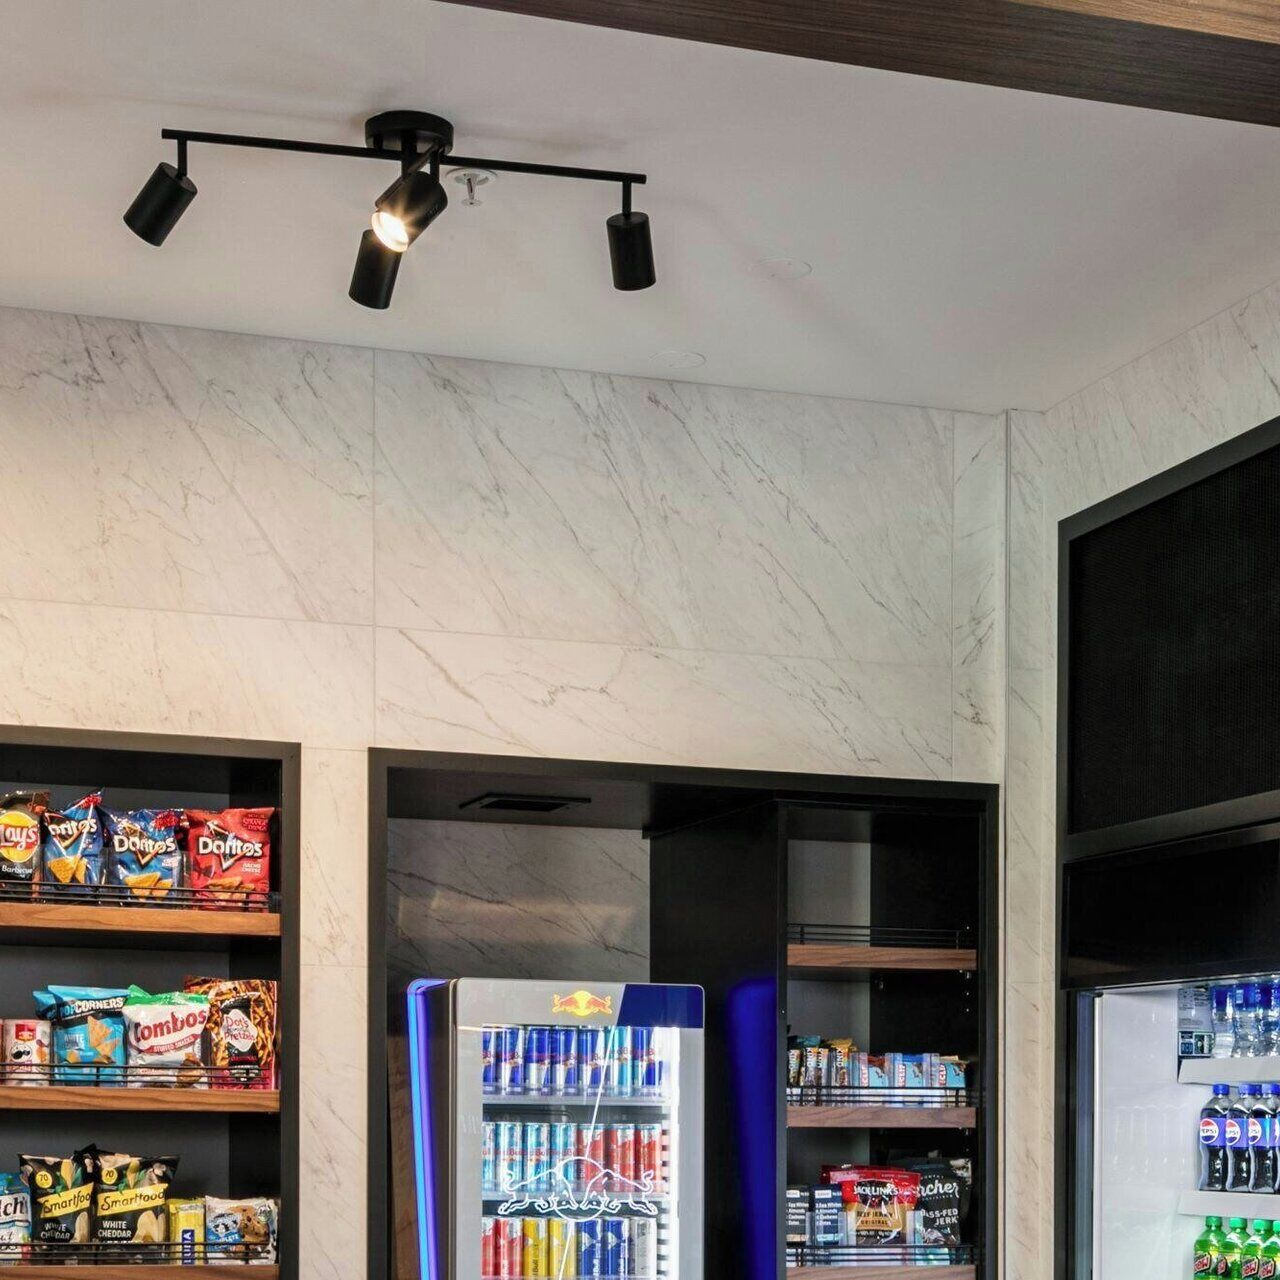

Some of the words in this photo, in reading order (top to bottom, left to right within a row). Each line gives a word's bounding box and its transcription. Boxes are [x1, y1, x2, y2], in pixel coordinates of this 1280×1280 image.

[48, 818, 98, 837] oritos
[112, 834, 176, 856] Doritos
[197, 837, 263, 857] Doritos
[1, 864, 34, 876] Barbecue
[133, 1009, 207, 1043] Combos
[225, 1017, 248, 1029] Dot's
[223, 1030, 256, 1042] Pretzels
[153, 1042, 174, 1053] STUFFED
[38, 1172, 49, 1183] 70
[105, 1170, 115, 1179] 70
[42, 1191, 92, 1213] Smartfoo
[100, 1190, 166, 1211] Smartfood
[44, 1222, 67, 1232] WHITE
[102, 1220, 128, 1230] WHITE
[40, 1230, 71, 1240] CHEDDAR
[97, 1228, 132, 1238] CHEDDAR
